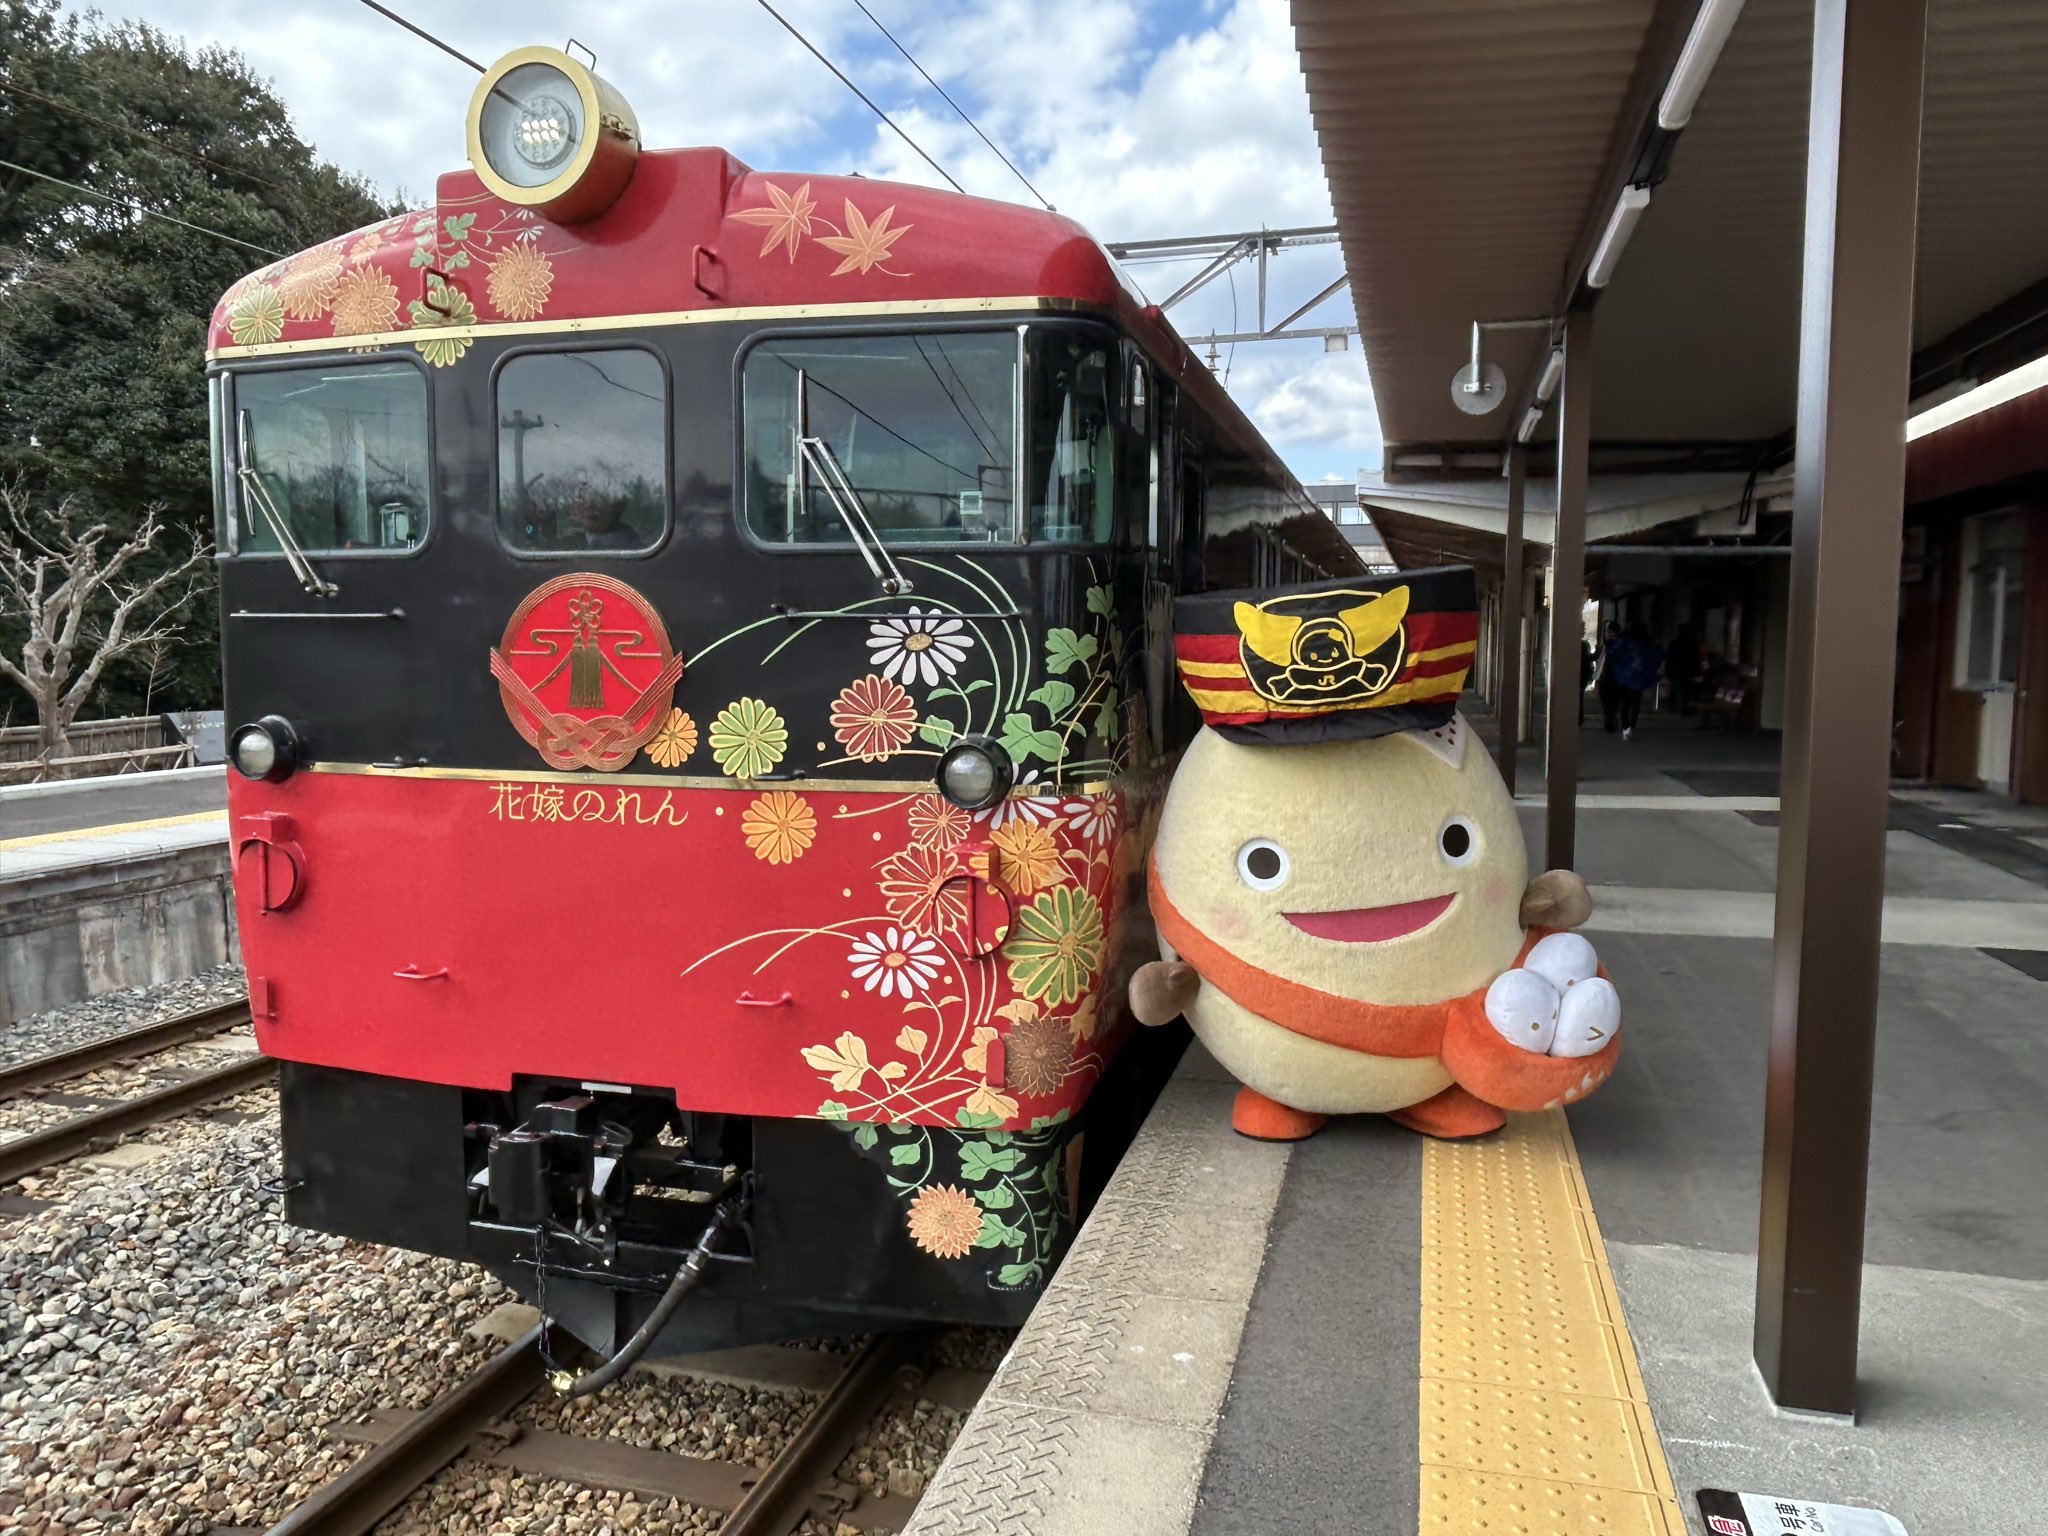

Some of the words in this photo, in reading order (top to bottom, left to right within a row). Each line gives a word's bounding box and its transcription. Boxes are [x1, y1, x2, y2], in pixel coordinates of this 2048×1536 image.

[1318, 674, 1336, 686] JR
[488, 782, 689, 826] 花嫁のれん
[1774, 1502, 1807, 1536] 号車
